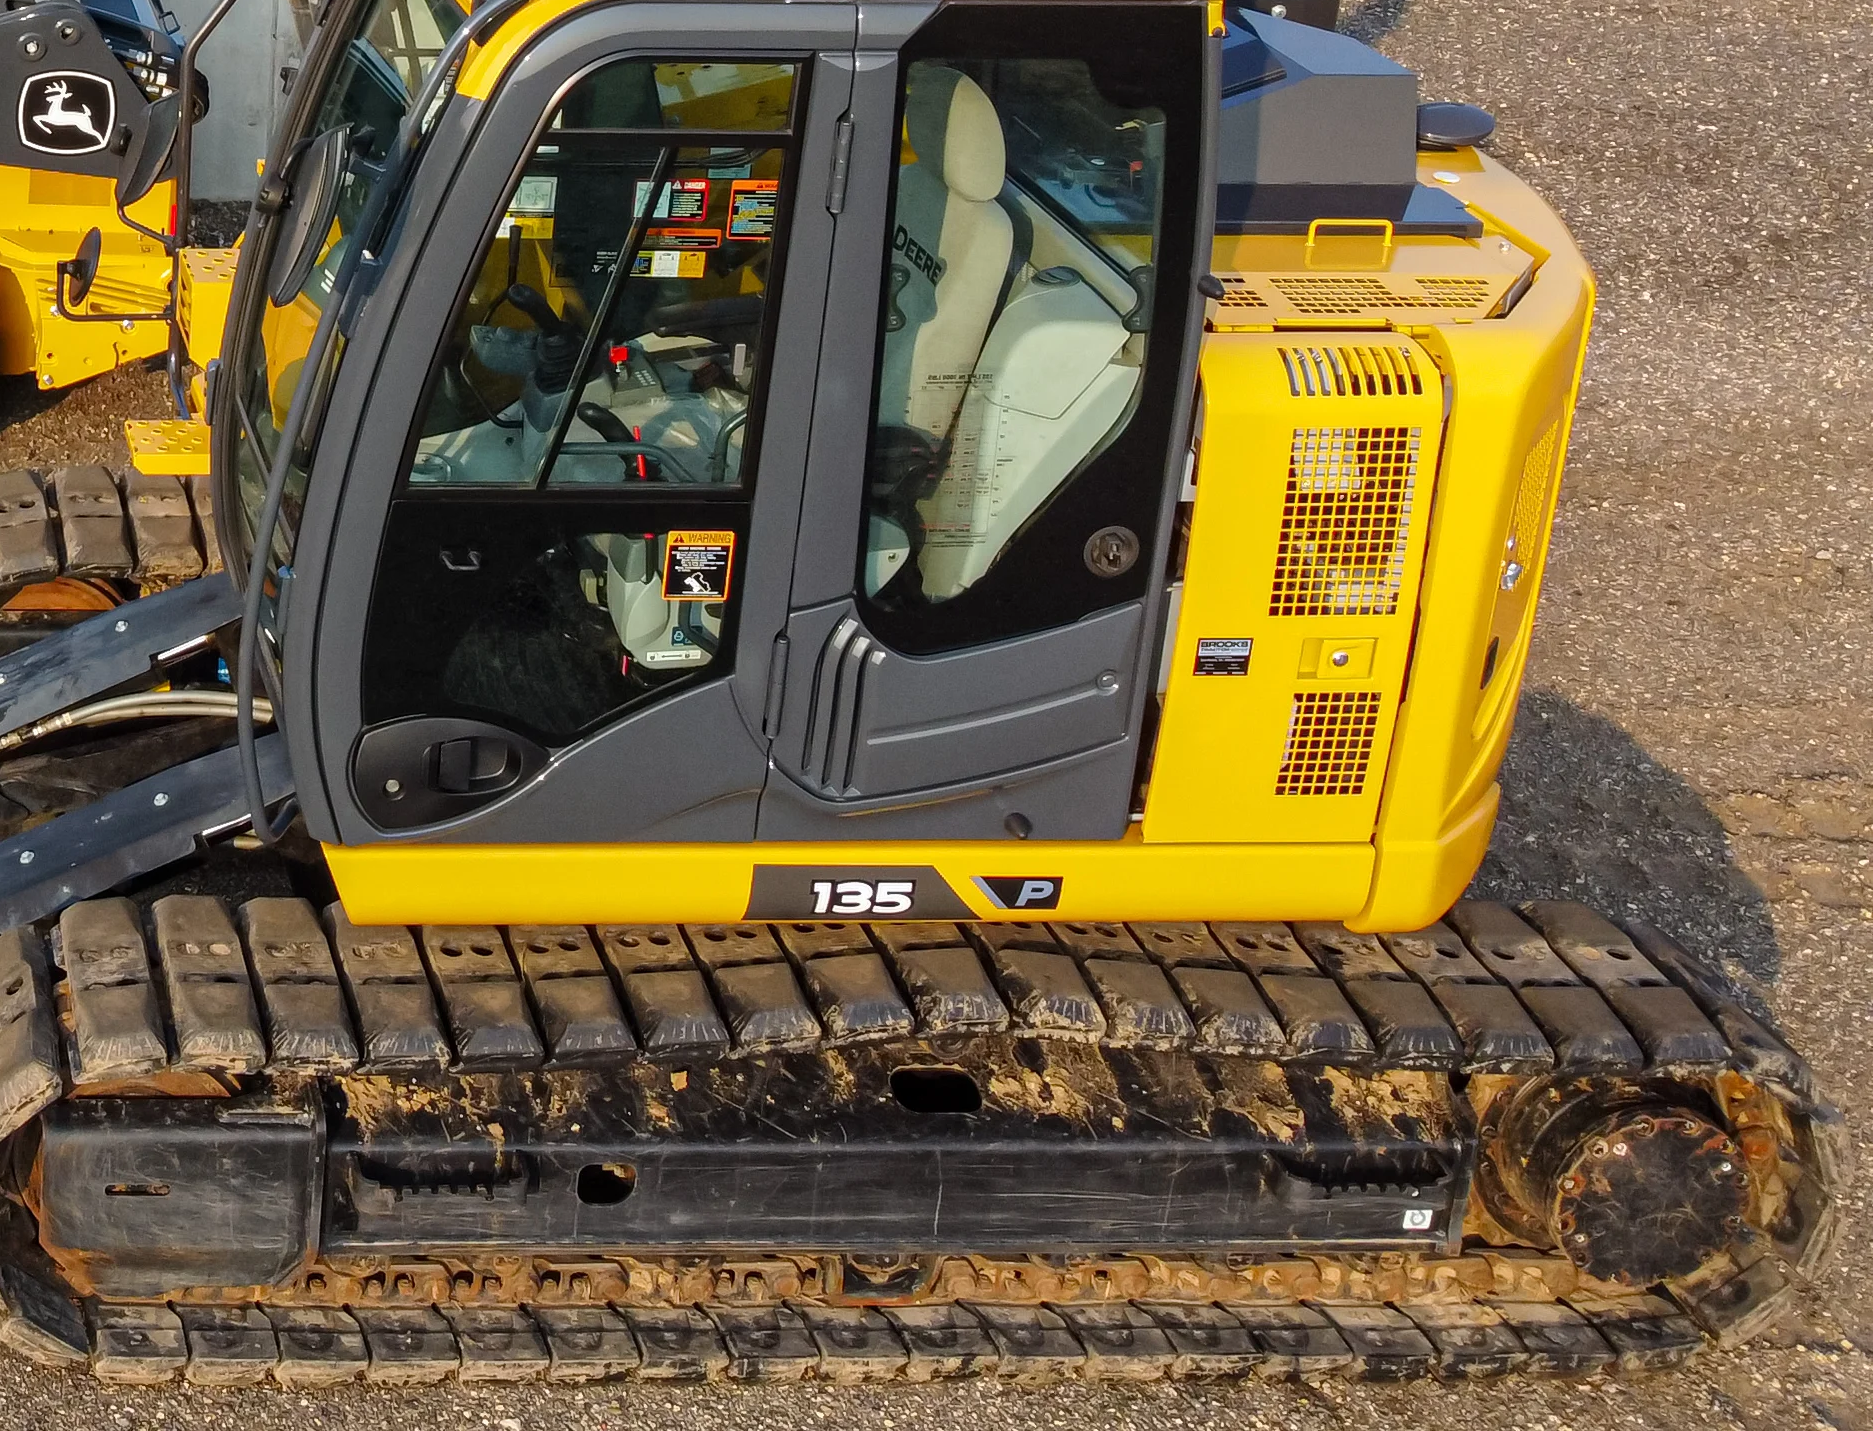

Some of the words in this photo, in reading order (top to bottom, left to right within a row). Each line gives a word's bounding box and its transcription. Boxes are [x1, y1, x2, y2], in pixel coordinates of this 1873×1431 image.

[893, 224, 943, 287] DEERE
[688, 533, 732, 544] WARNING
[812, 881, 913, 914] 135
[1014, 880, 1054, 907] P
